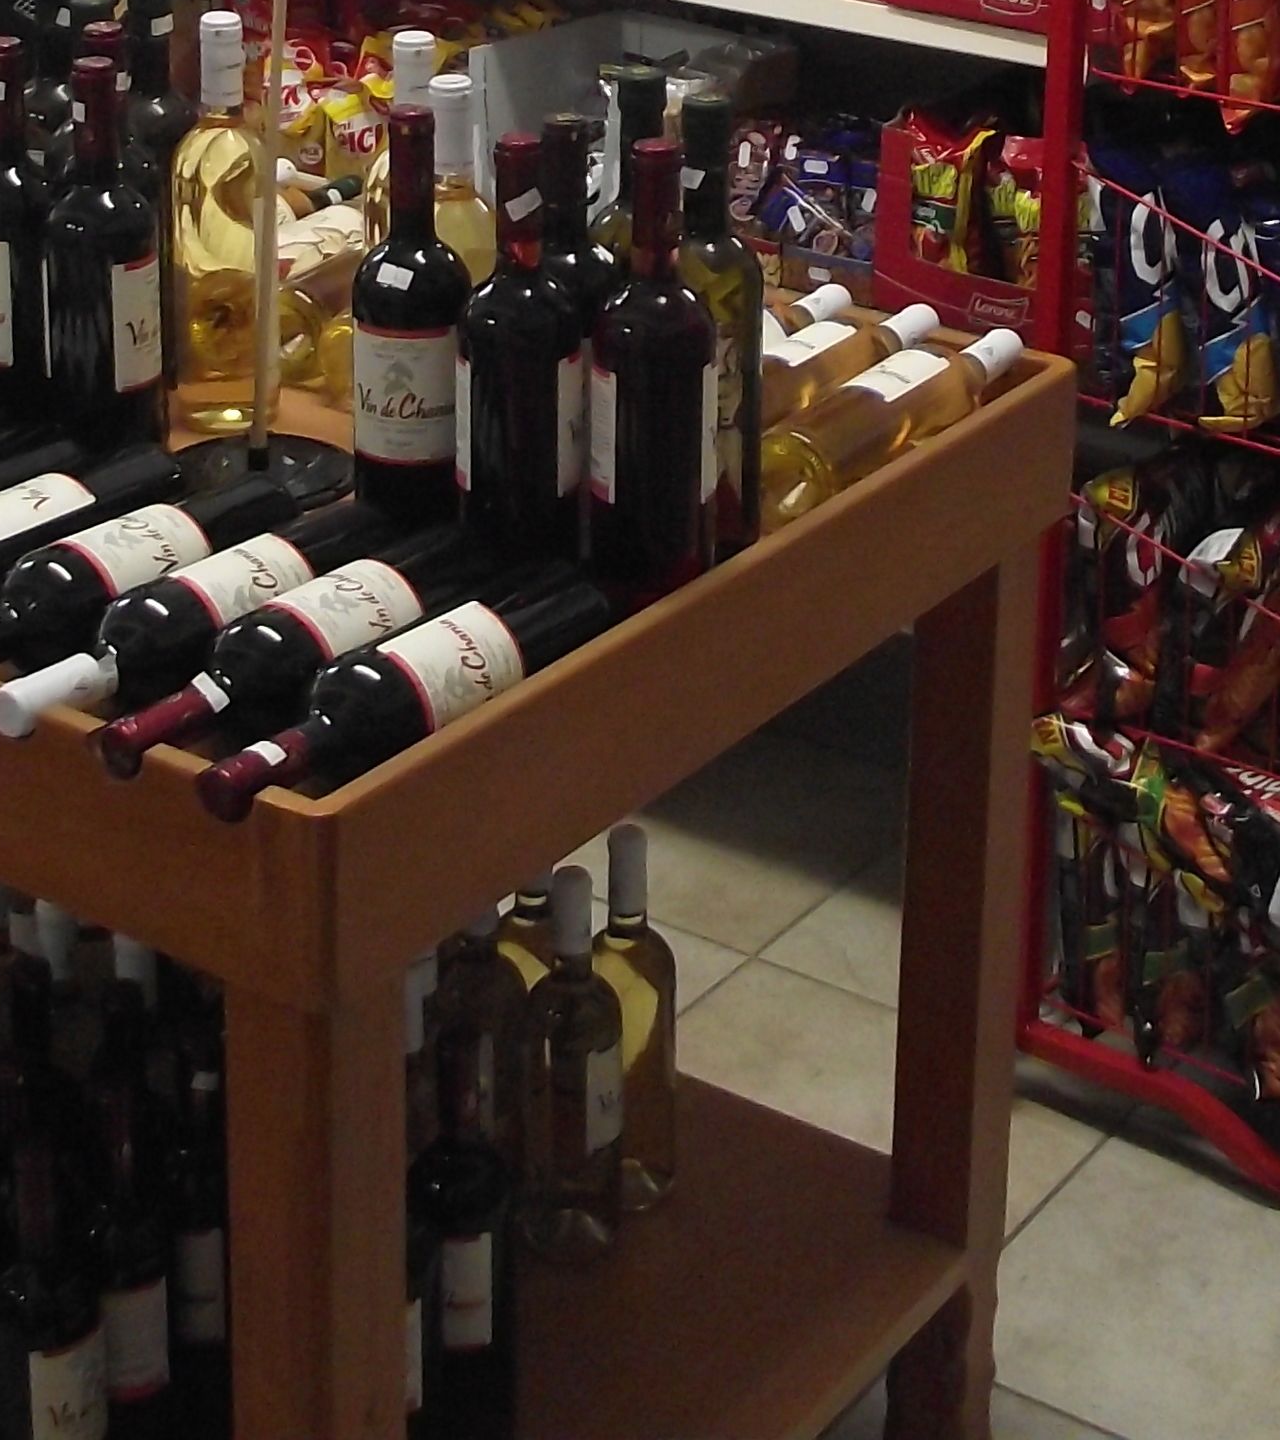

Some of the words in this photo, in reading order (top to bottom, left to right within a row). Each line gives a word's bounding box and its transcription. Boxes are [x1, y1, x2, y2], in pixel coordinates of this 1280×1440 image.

[357, 382, 378, 414] Vin
[380, 398, 396, 418] de
[152, 543, 179, 576] Vin
[367, 608, 393, 634] Vin
[439, 619, 487, 670] Chania
